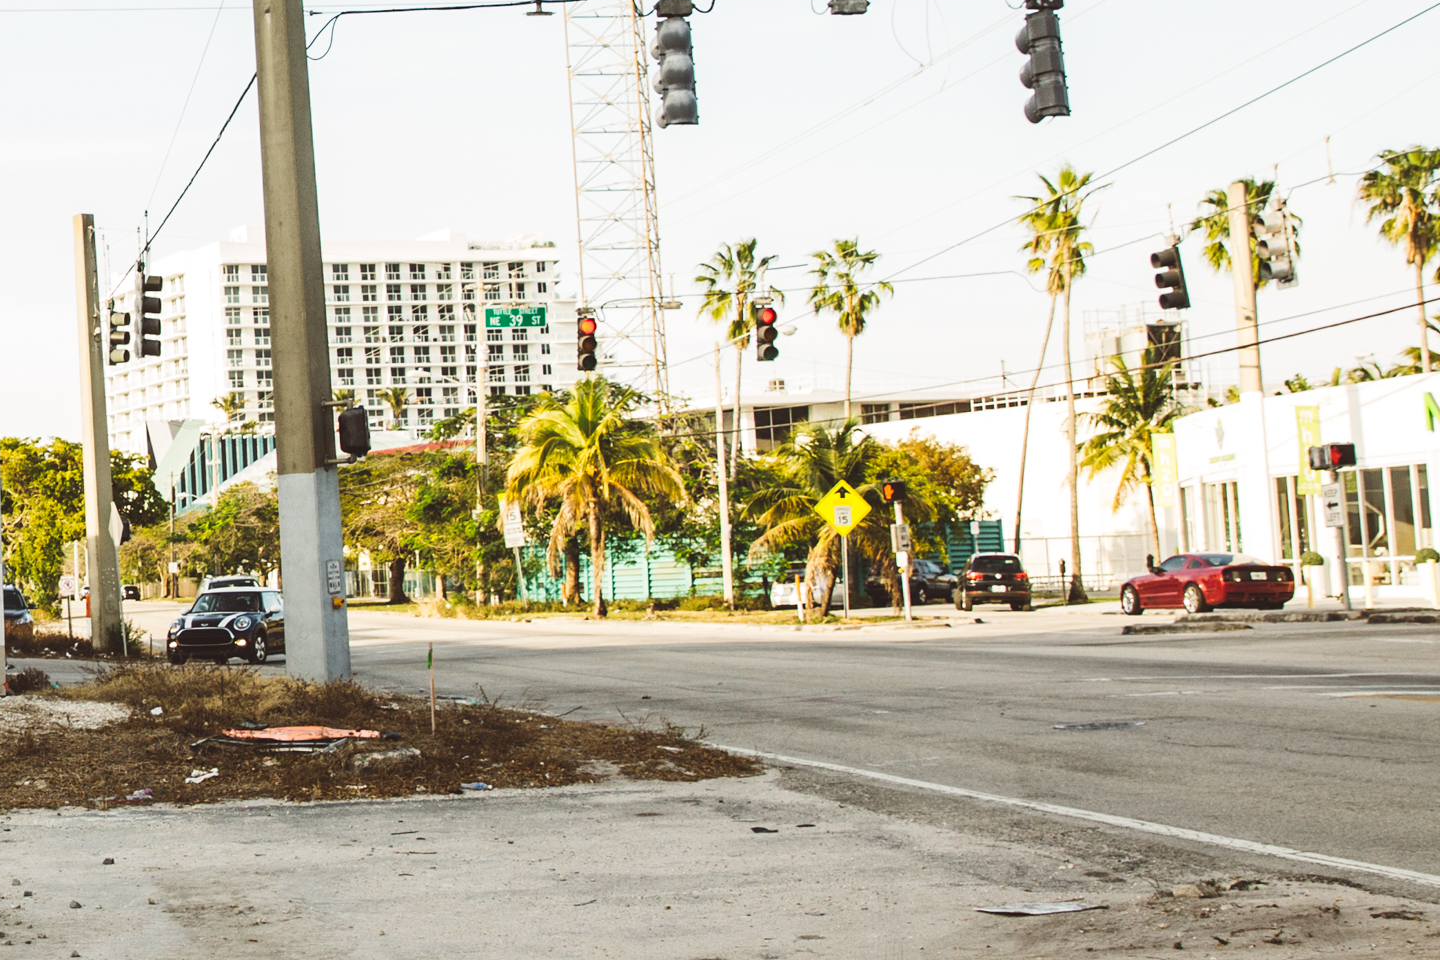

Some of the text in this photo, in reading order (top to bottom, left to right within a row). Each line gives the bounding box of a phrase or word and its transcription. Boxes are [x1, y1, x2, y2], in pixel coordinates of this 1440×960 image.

[490, 315, 541, 327] NE 39 ST
[838, 516, 848, 524] 15
